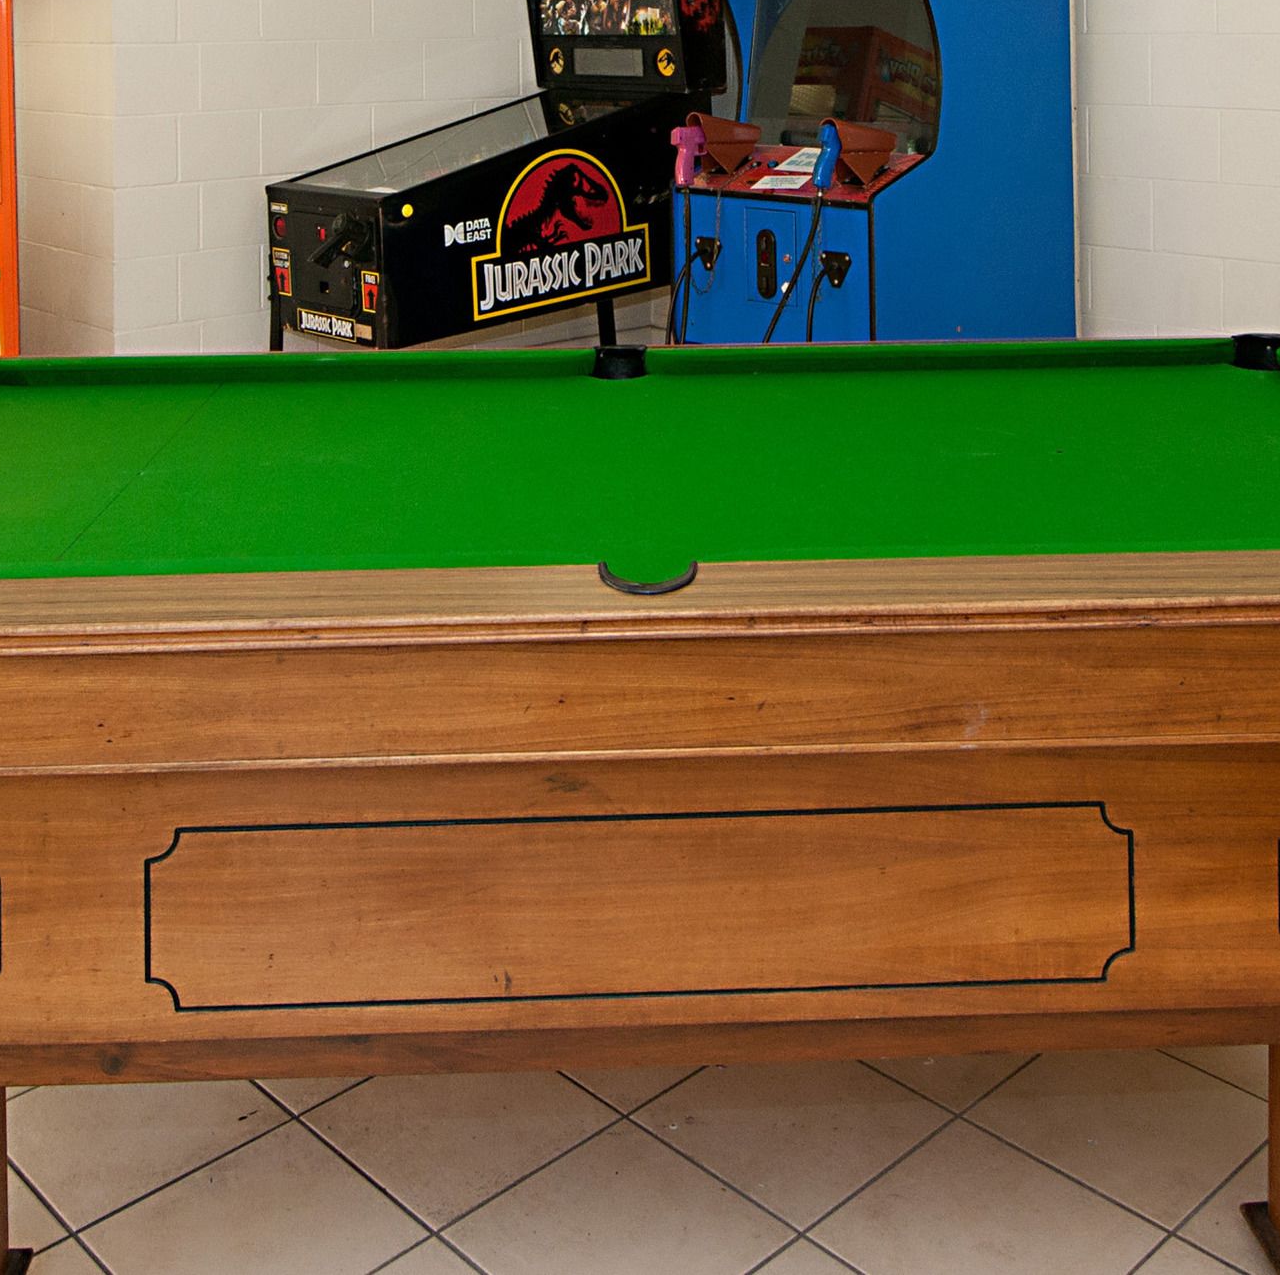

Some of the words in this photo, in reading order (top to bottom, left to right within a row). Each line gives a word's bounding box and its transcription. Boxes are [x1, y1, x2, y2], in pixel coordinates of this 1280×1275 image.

[465, 217, 490, 231] DATA
[466, 228, 493, 243] EAST
[480, 250, 582, 311] JURASSIC
[584, 238, 645, 287] PARK
[300, 311, 332, 333] JURASSIC
[332, 315, 353, 338] PARK
